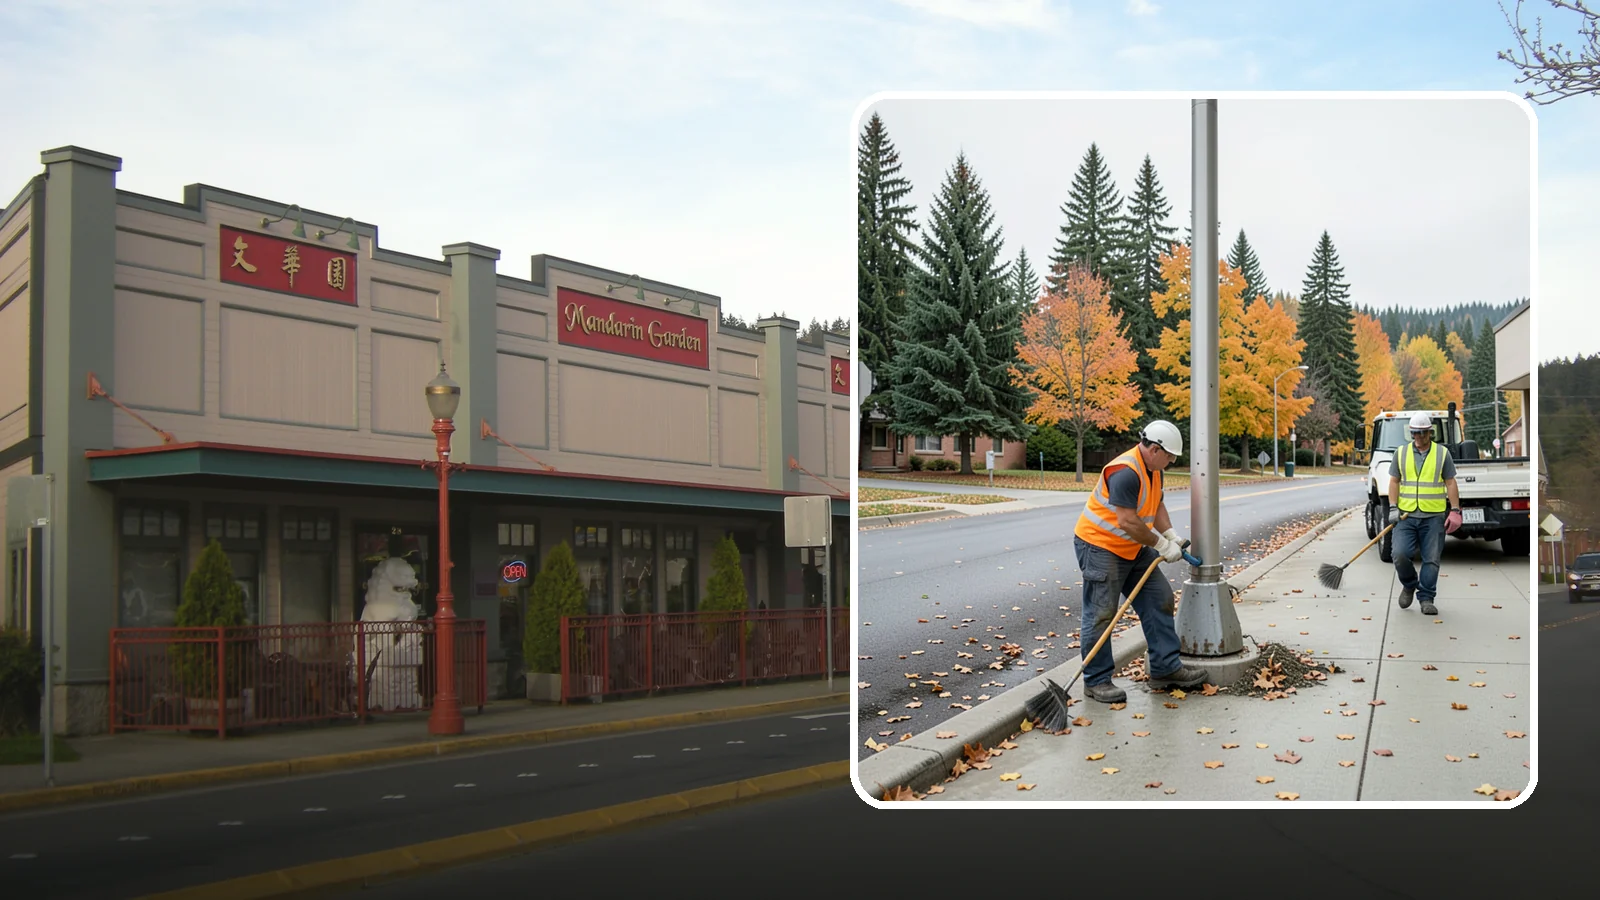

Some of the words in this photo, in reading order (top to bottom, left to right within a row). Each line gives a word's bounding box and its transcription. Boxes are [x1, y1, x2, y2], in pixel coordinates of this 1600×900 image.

[230, 235, 347, 291] 文華園
[564, 302, 644, 341] Mandarin
[647, 320, 701, 352] Garden
[503, 565, 527, 578] OPEN
